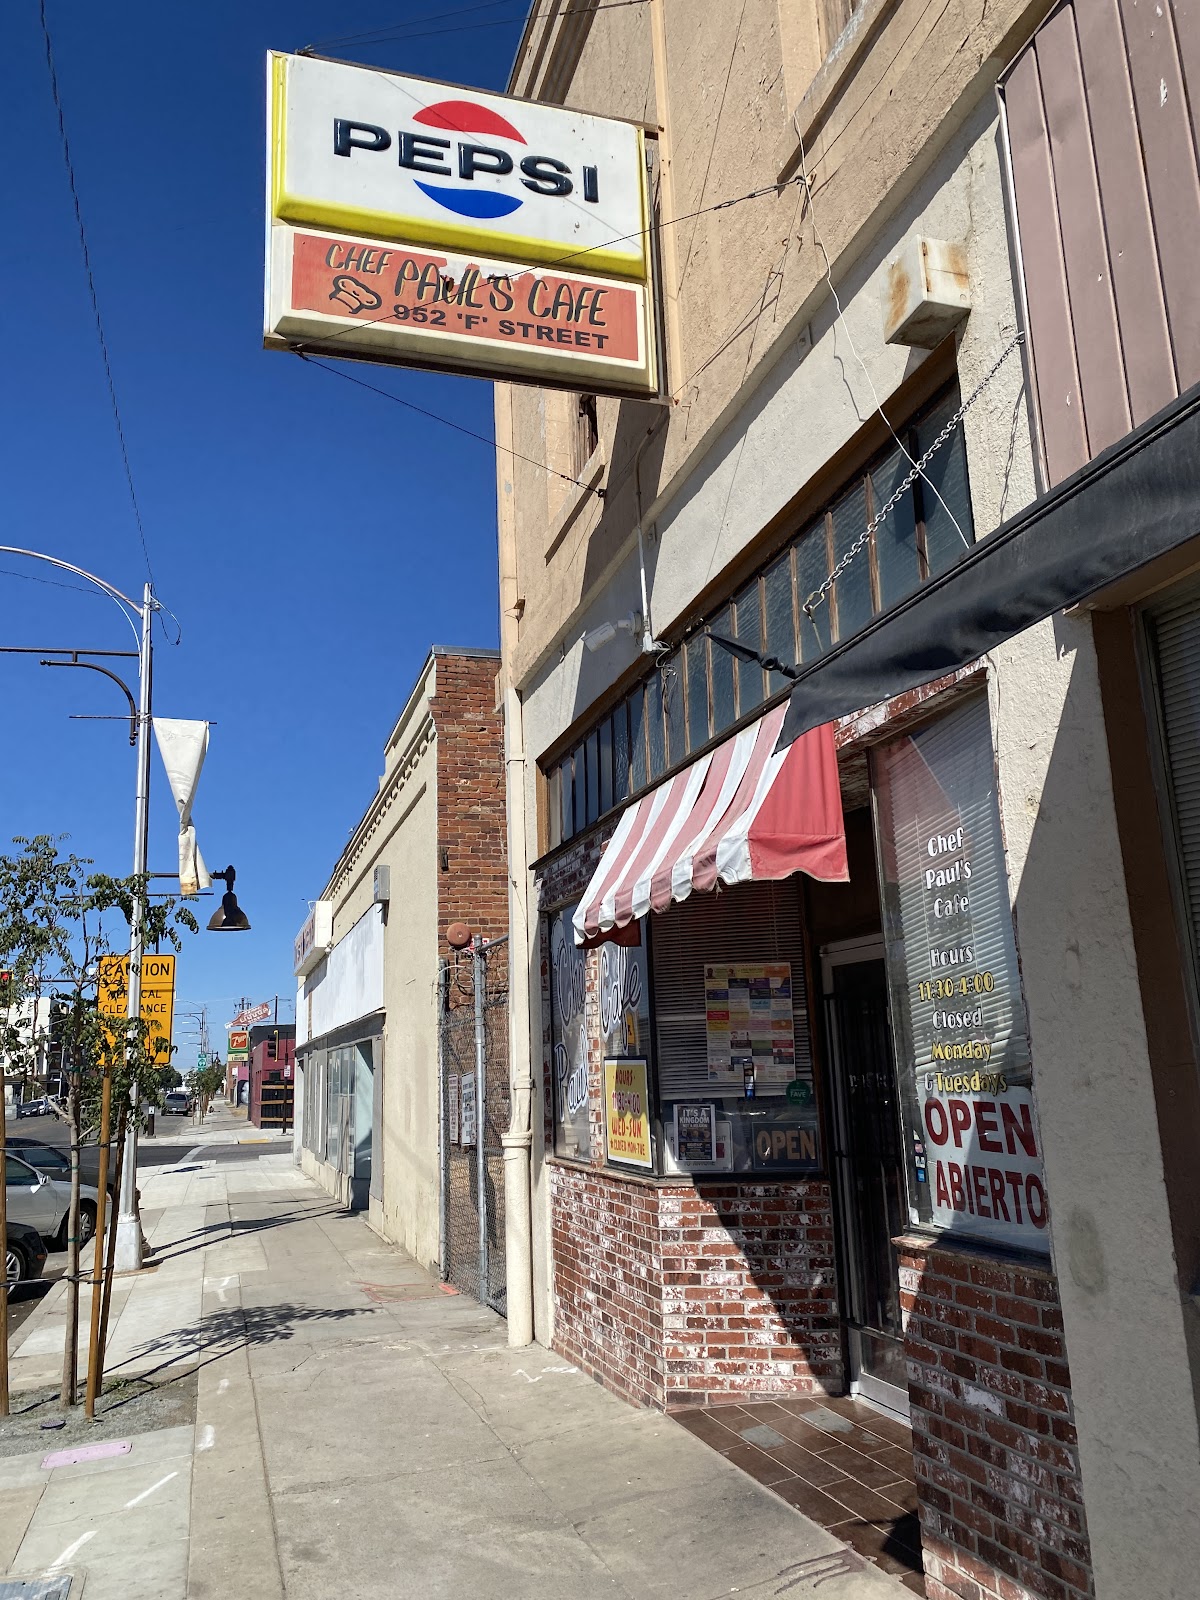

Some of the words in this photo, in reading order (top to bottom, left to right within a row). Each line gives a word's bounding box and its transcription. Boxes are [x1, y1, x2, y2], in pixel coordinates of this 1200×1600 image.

[333, 118, 600, 203] PEPSI
[326, 243, 392, 275] CHEF
[526, 277, 608, 328] CAFE
[393, 304, 447, 328] 952
[455, 312, 488, 332] 'F'
[498, 320, 610, 350] STREET
[927, 827, 965, 857] Chef
[925, 860, 972, 890] Paul's
[932, 894, 970, 920] Cafe
[104, 963, 170, 977] CAION
[930, 945, 974, 968] Hours
[917, 970, 995, 1002] 11:30-4:00
[102, 1003, 167, 1014] CLEAANCE
[600, 945, 643, 1056] Cafe
[932, 1007, 983, 1031] Closed
[931, 1041, 992, 1062] Monday
[615, 1069, 633, 1086] HOURS
[936, 1070, 1007, 1097] Tuesdays
[679, 1116, 710, 1124] KINGDOM
[682, 1109, 699, 1117] IT'S
[700, 1109, 707, 1117] A
[611, 1117, 642, 1139] WED-SUN
[924, 1096, 1038, 1158] OPEN
[756, 1130, 816, 1161] OPEN
[936, 1160, 1048, 1229] ABIERTO
